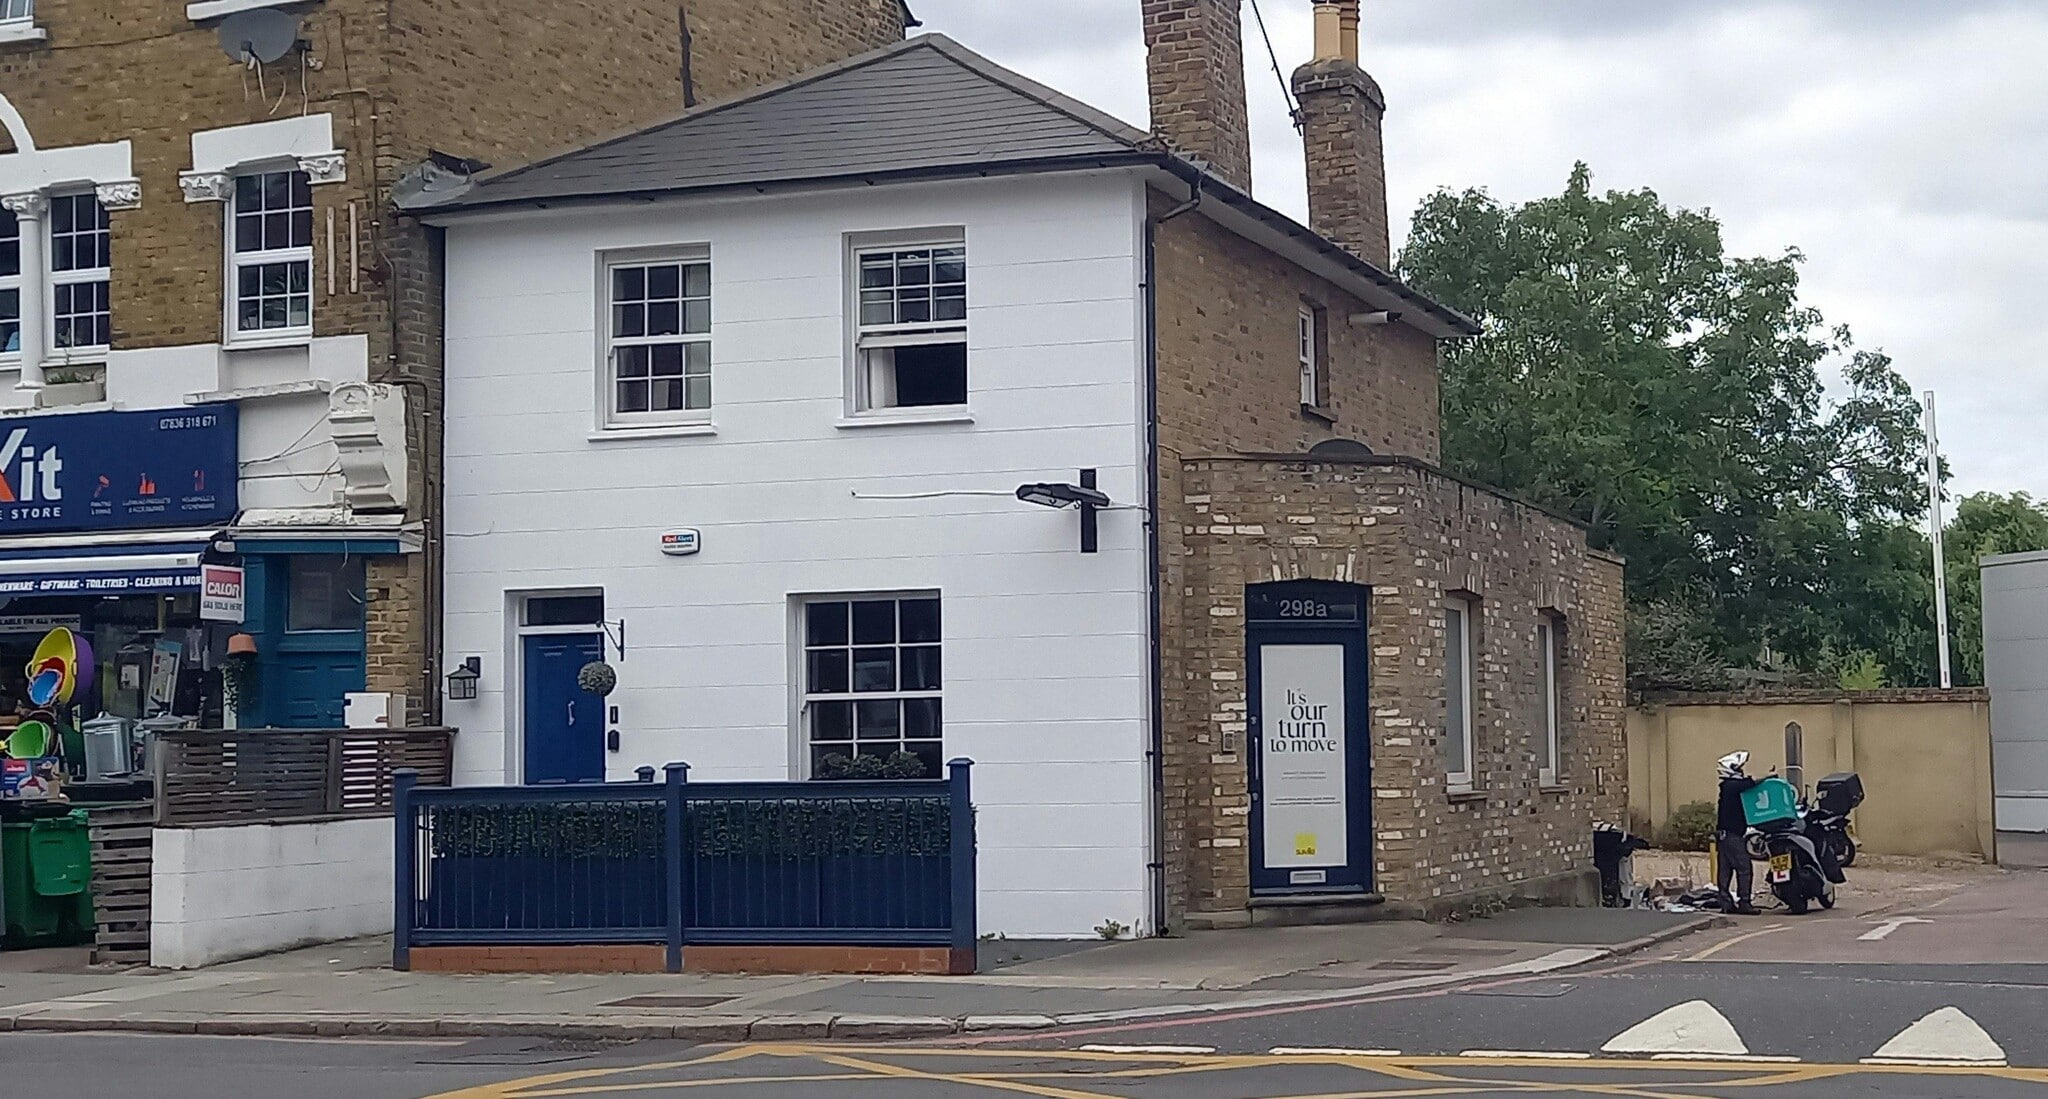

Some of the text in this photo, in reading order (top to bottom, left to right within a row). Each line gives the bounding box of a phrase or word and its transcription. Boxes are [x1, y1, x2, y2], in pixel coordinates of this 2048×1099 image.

[11, 506, 62, 520] STORE
[40, 579, 80, 590] GIFTWARE
[135, 577, 173, 588] CLEANING
[207, 581, 240, 599] CALOR
[1279, 599, 1328, 617] 298a
[1287, 688, 1307, 705] It's
[1290, 705, 1328, 721] our
[1278, 719, 1327, 738] turn
[1270, 739, 1337, 752] to move
